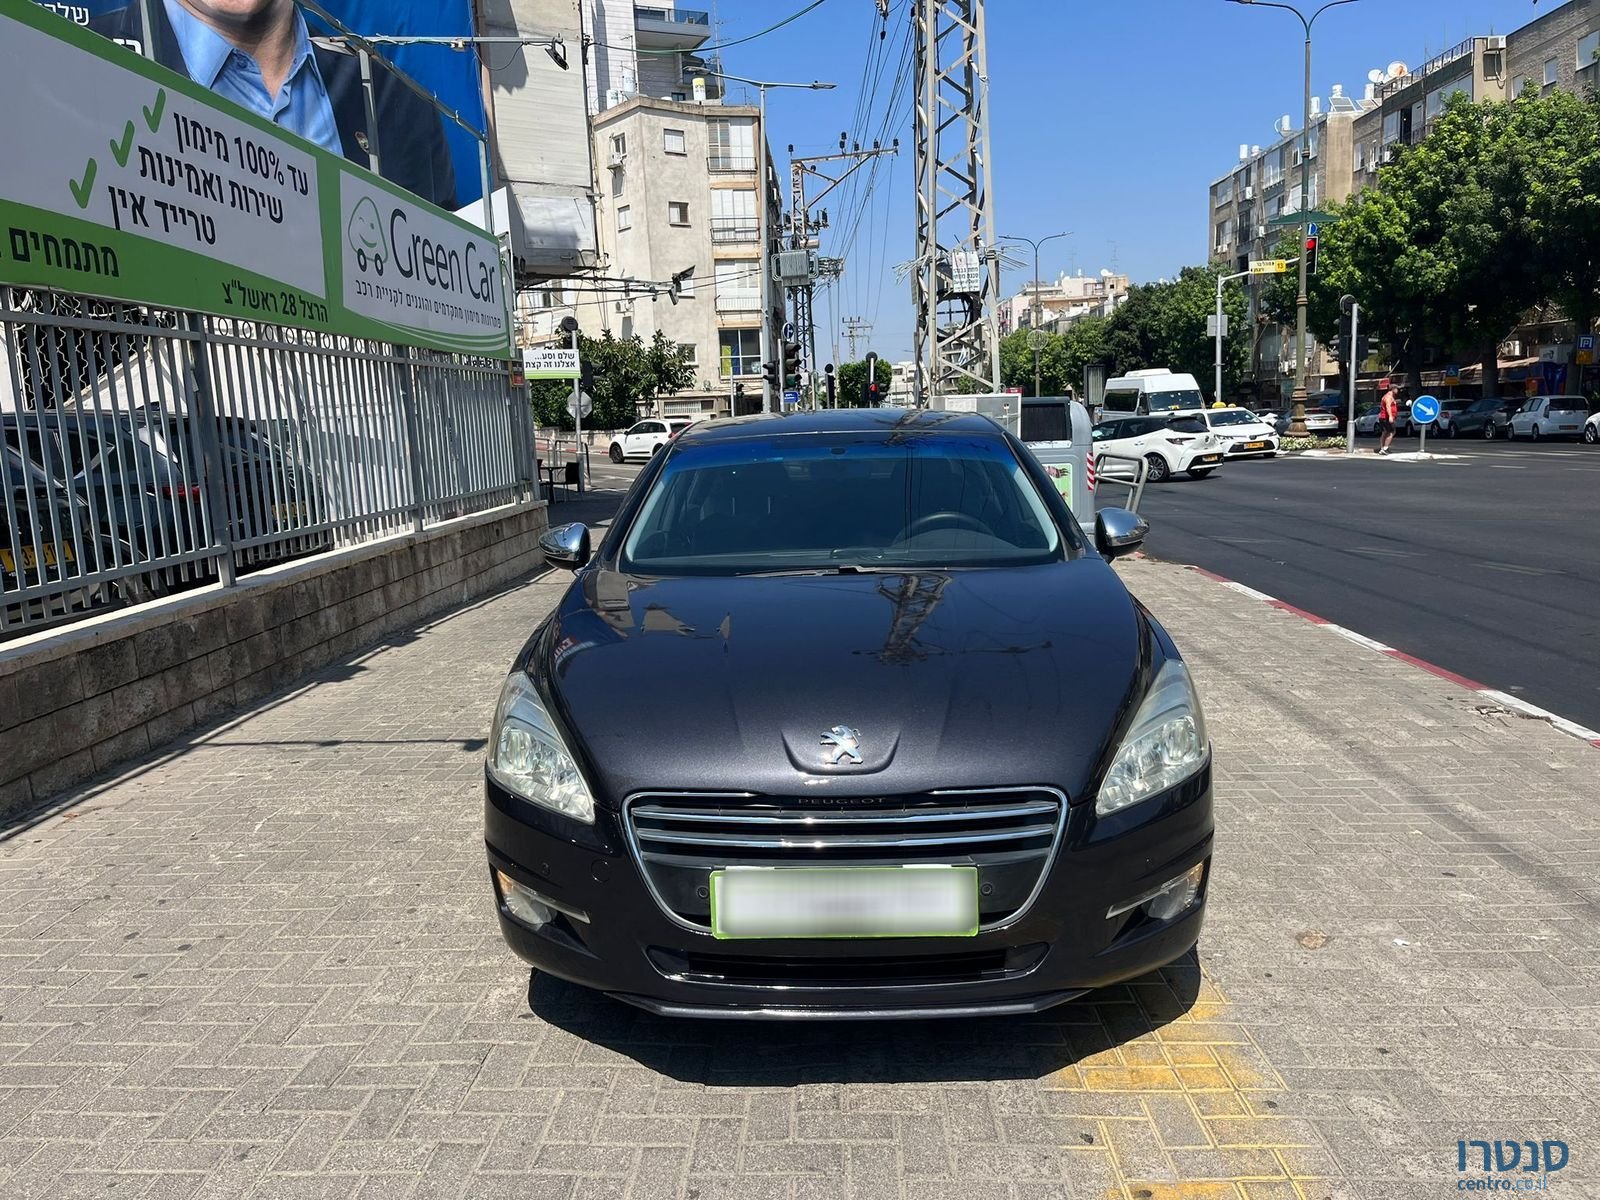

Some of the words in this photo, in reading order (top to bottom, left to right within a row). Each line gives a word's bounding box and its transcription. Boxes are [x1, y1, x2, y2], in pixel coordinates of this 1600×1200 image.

[173, 112, 230, 164] מימון
[138, 145, 224, 204] ואמינות
[234, 136, 285, 187] 100%
[287, 164, 309, 196] עד
[108, 185, 150, 231] אין
[228, 179, 283, 224] שירות
[154, 199, 216, 245] טרייד
[8, 226, 120, 278] מתמחים
[390, 208, 463, 294] Green
[465, 241, 495, 304] Car
[355, 279, 374, 298] רכב
[375, 285, 403, 308] לקניית
[405, 292, 433, 312] והוגנים
[280, 291, 297, 317] 28
[299, 295, 329, 323] הרצל
[433, 300, 464, 321] מתקדמים
[464, 309, 480, 325] מימון
[525, 361, 542, 370] קצת
[554, 360, 576, 368] אצלנו
[557, 351, 575, 360] שלם
[798, 797, 887, 805] PEUGEOT
